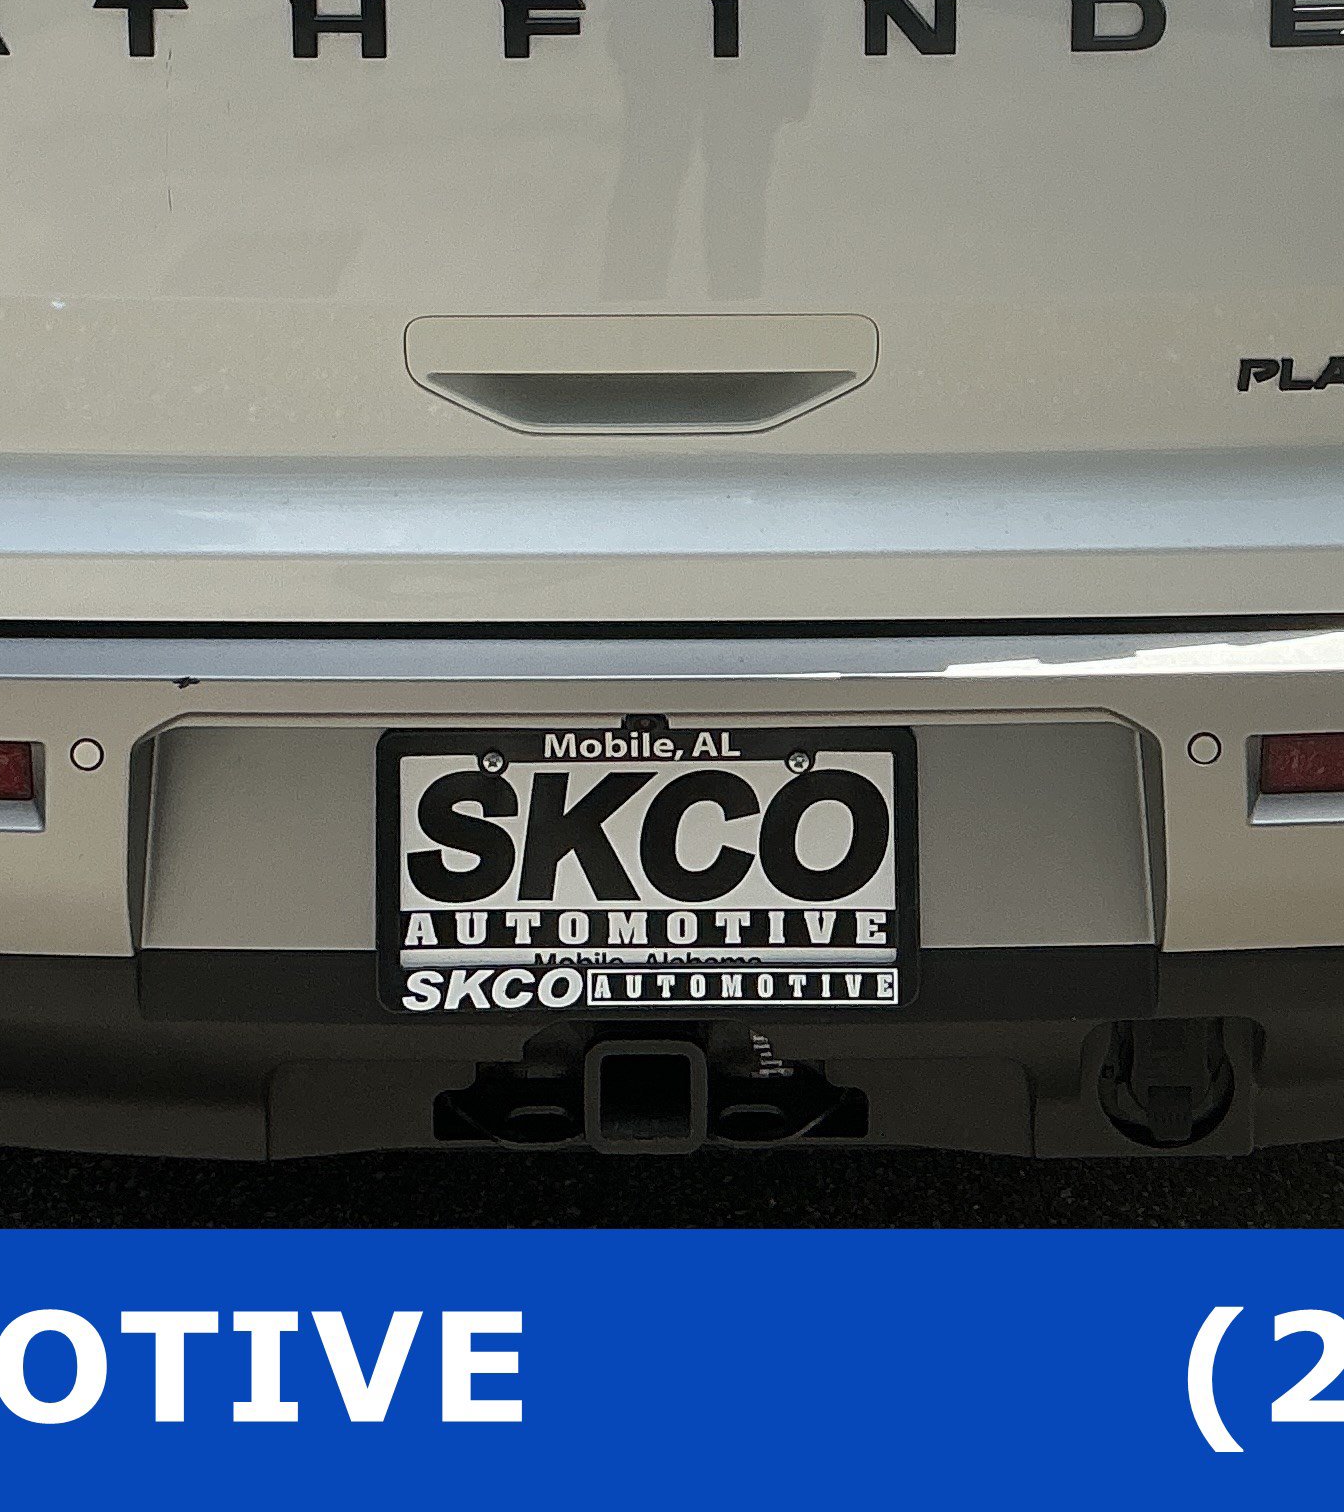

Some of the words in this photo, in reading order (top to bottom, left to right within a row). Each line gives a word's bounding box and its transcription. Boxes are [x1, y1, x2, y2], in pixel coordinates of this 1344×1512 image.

[543, 733, 684, 760] Mobile,
[692, 733, 740, 757] AL
[407, 769, 889, 903] SKCO
[404, 911, 887, 945] AUTOMOTIVE
[402, 968, 583, 1010] SKCO
[593, 973, 893, 999] AUTOMOTIVE
